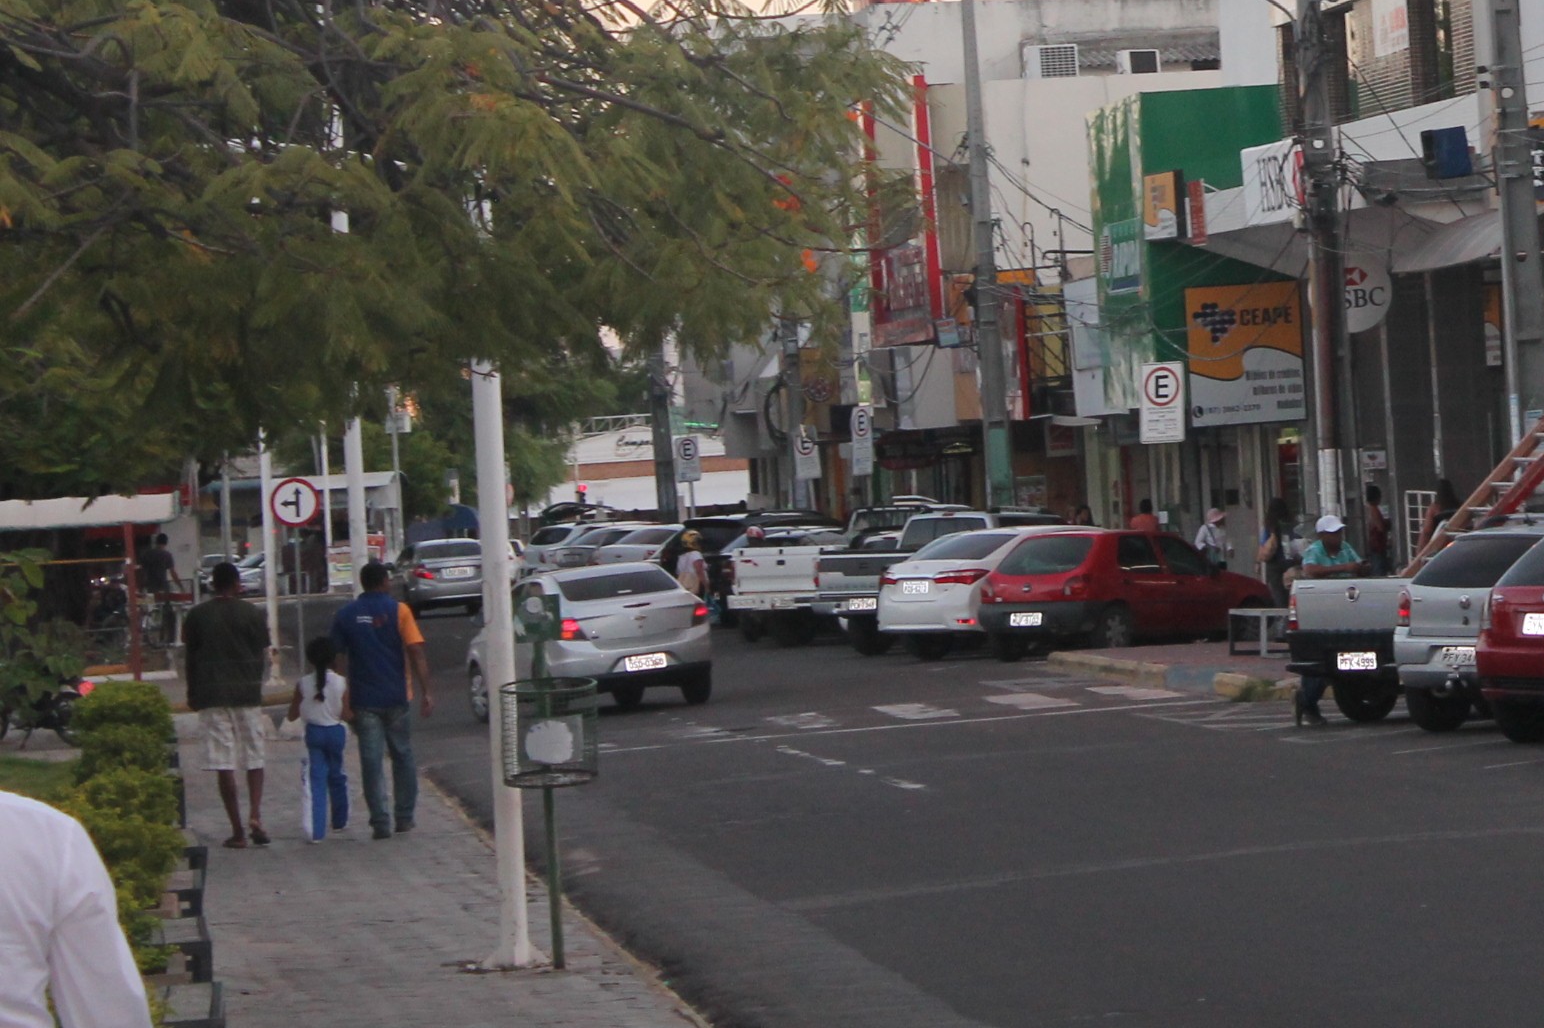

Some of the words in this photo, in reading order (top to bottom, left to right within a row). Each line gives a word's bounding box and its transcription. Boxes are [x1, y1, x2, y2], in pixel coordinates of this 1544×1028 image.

[1343, 285, 1386, 310] SBC
[1239, 306, 1294, 327] CEAPE
[1154, 374, 1170, 399] E
[858, 413, 867, 432] E
[683, 442, 692, 458] E
